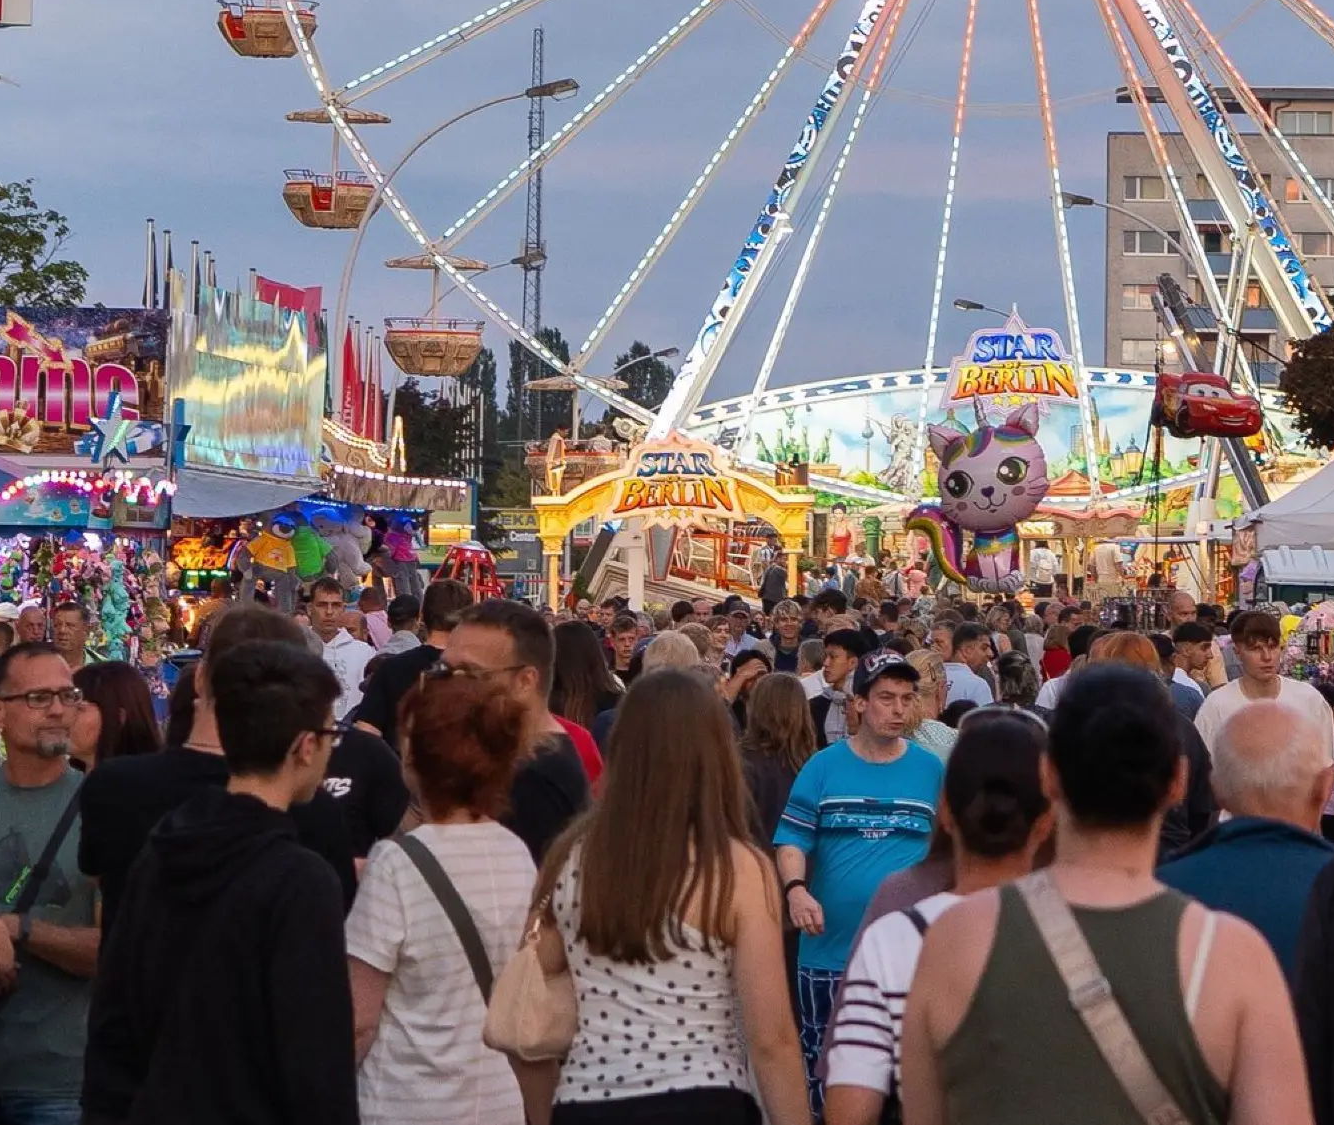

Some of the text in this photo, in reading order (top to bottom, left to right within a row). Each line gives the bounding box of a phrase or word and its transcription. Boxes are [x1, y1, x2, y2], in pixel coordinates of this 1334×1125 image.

[972, 332, 1061, 363] STAR
[951, 362, 1079, 401] BERLIN
[636, 452, 717, 477] STAR
[613, 478, 734, 514] BERLIN
